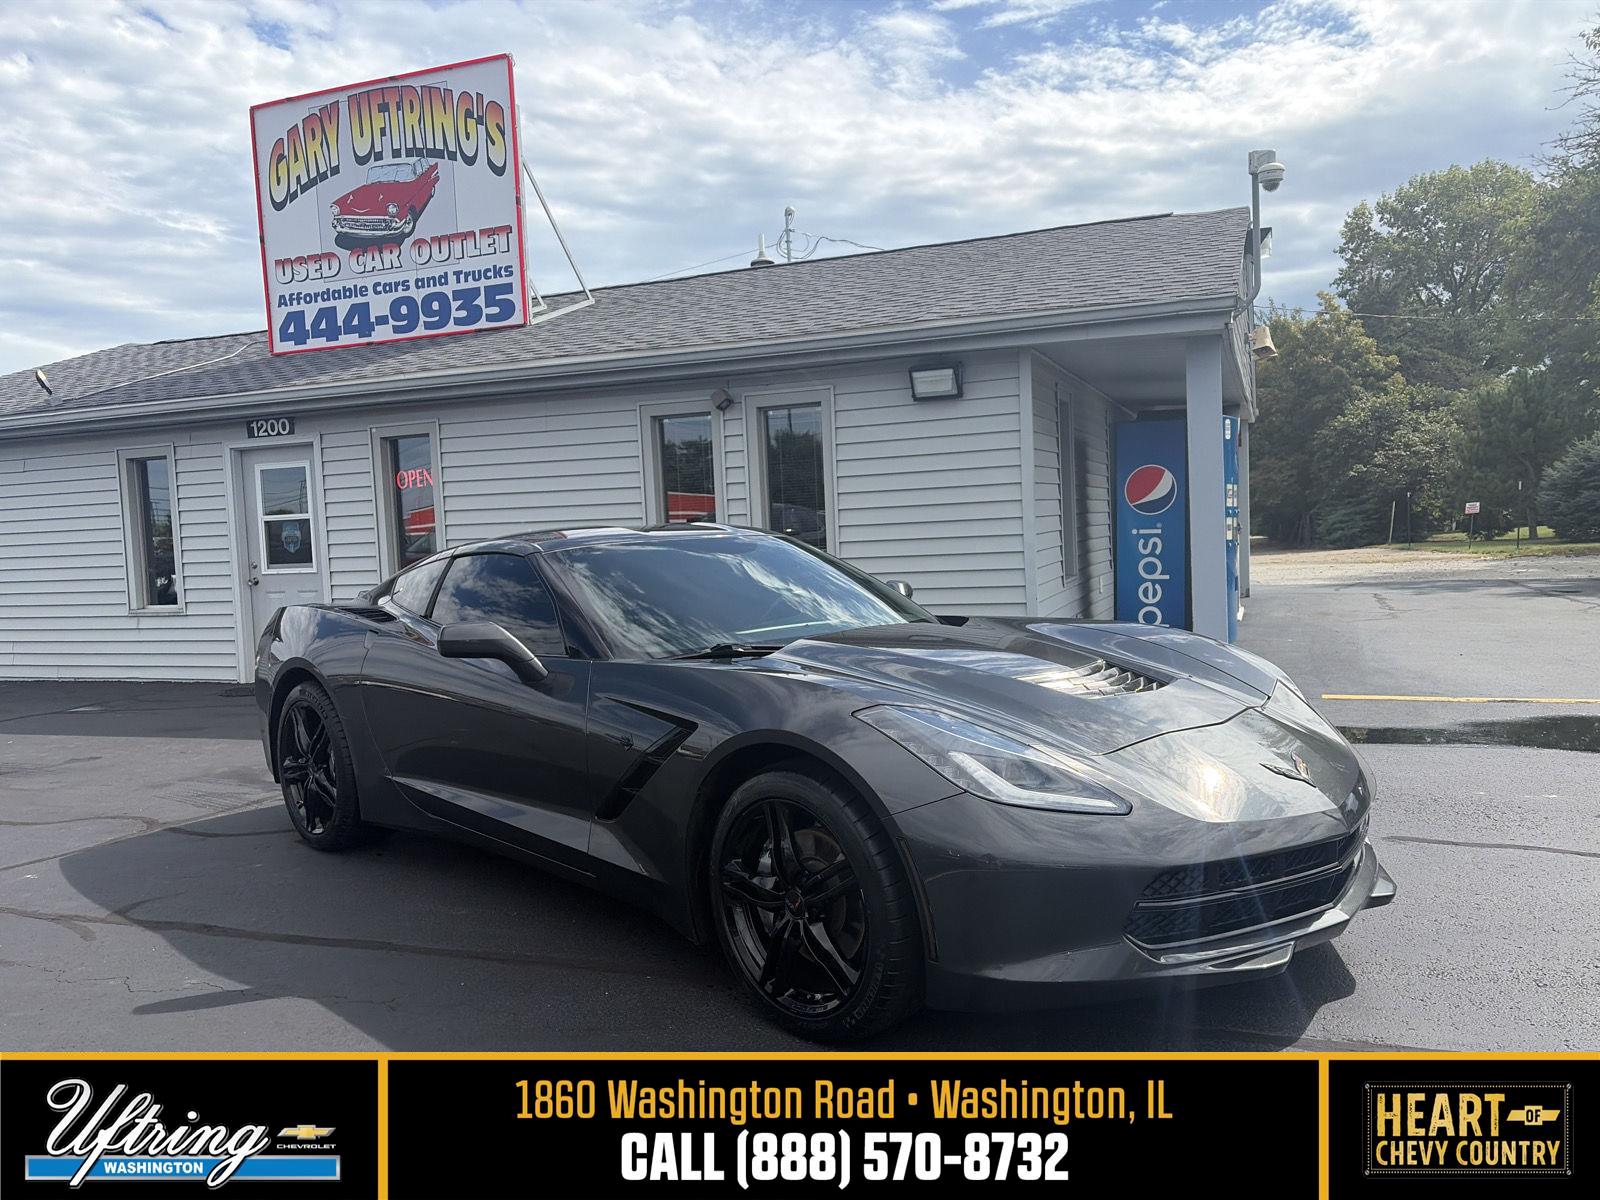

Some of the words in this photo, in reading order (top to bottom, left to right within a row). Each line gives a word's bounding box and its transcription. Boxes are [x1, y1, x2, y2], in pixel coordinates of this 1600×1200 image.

[268, 100, 340, 212] GARY
[347, 85, 507, 177] UFTRING'S
[274, 251, 341, 285] USED
[349, 243, 402, 274] CAR
[410, 224, 512, 265] OUTLET
[277, 284, 368, 308] Affordable
[372, 279, 410, 296] Cars
[415, 272, 448, 289] and
[453, 264, 514, 284] Trucks
[278, 282, 516, 346] 444-9935
[250, 418, 290, 437] 1200
[396, 468, 433, 489] OPEN
